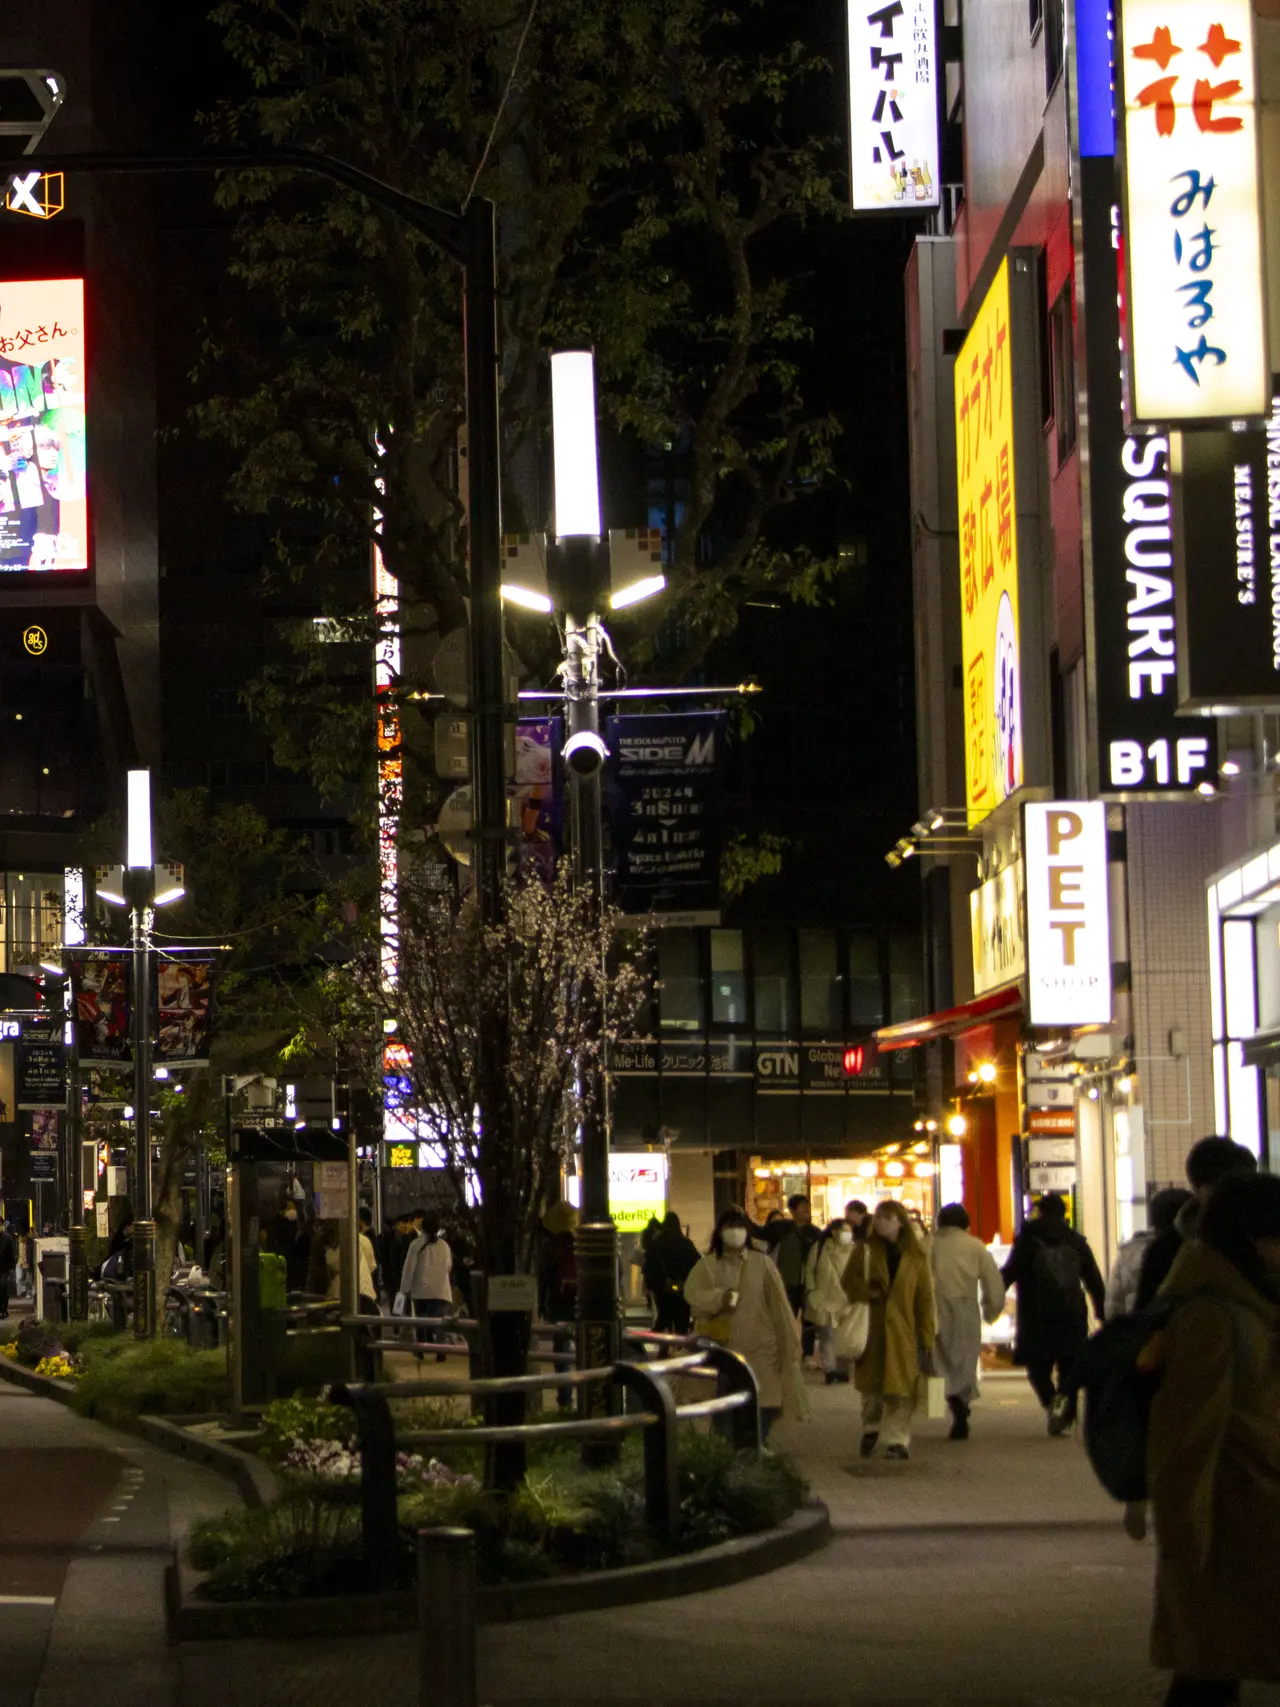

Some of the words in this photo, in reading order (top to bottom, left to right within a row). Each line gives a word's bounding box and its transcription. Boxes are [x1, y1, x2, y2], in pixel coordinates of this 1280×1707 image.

[867, 1, 905, 163] イケバル
[1132, 23, 1245, 138] 花
[1169, 169, 1227, 388] みはるや
[960, 307, 1007, 484] カラオケ
[1122, 437, 1176, 699] SQUARE
[1234, 464, 1257, 605] MEASURE'S
[1109, 738, 1208, 786] B1F
[1045, 810, 1087, 966] PET
[1041, 976, 1099, 989] SHOP
[662, 1055, 705, 1070] クリニック
[757, 1052, 799, 1076] GTN
[808, 1048, 842, 1064] Globa
